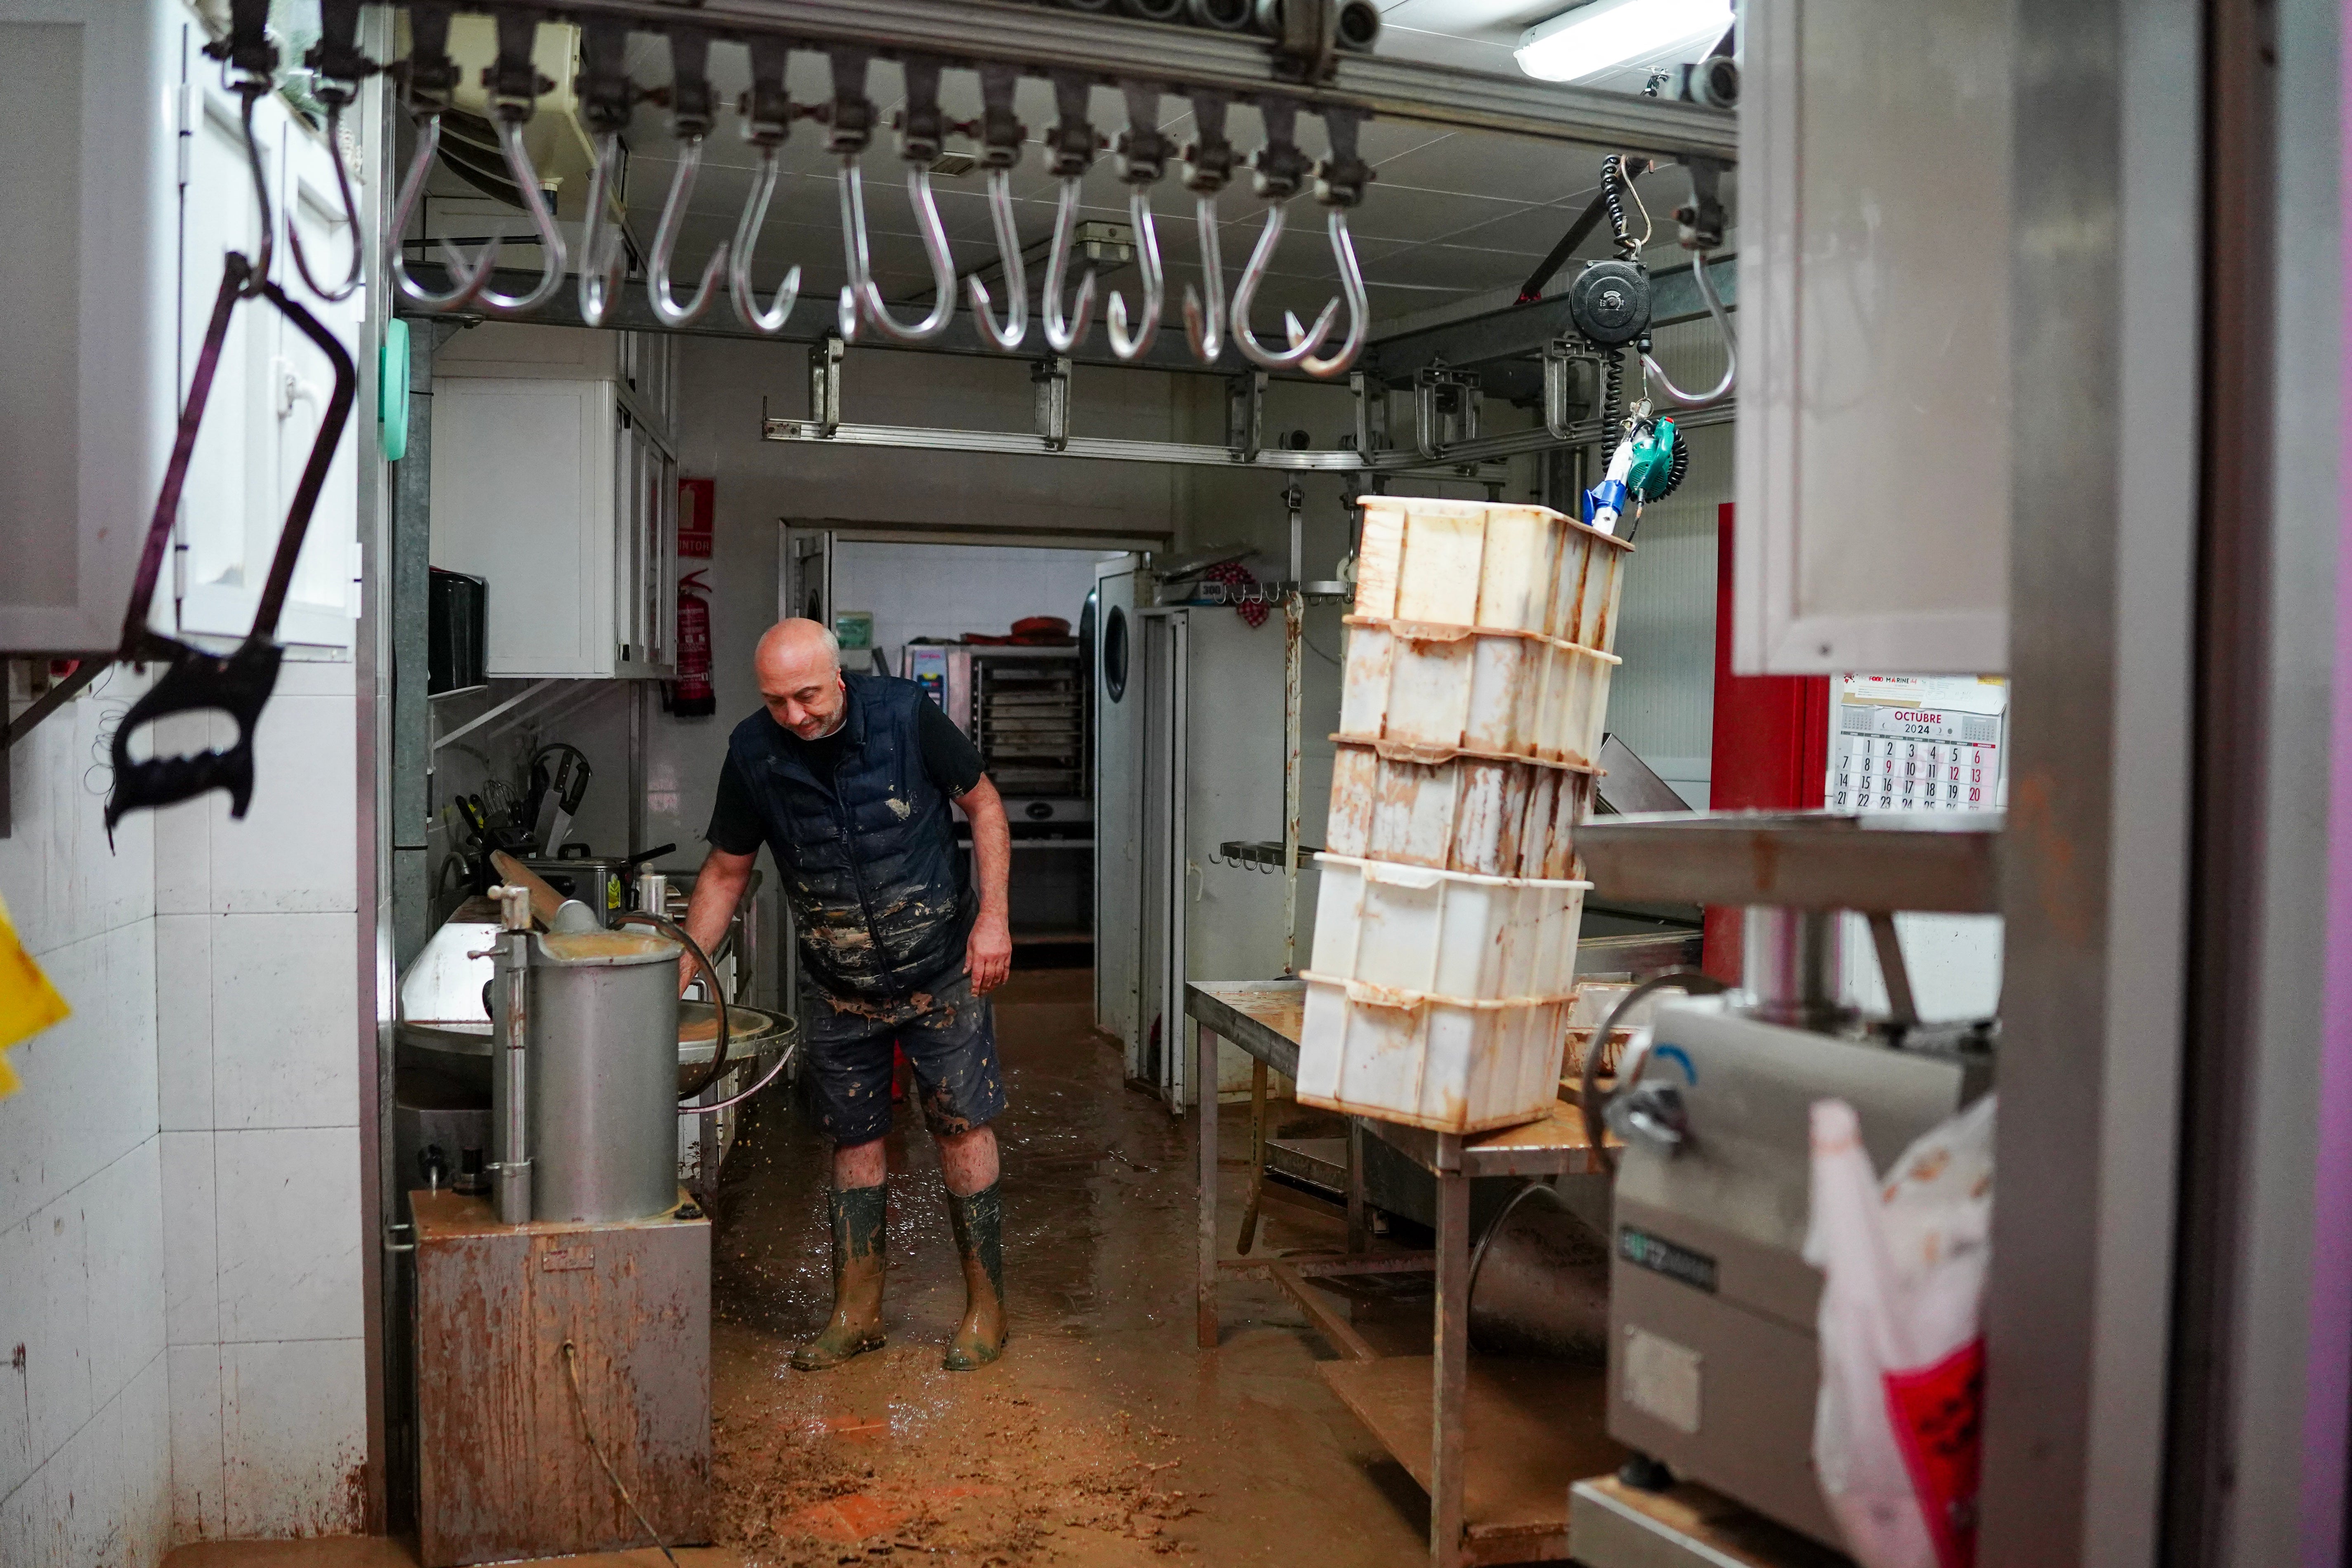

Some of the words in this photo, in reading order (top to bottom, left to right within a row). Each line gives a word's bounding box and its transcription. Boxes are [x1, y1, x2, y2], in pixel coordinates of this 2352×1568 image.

[1895, 711, 1941, 724] OCTUBRE
[1905, 724, 1929, 734] 2024
[1868, 740, 1870, 753] 1
[1887, 742, 1892, 755] 2
[1909, 744, 1914, 757] 3
[1931, 746, 1935, 759] 4
[1953, 749, 1958, 761] 5
[1975, 751, 1979, 764] 6
[1843, 756, 1849, 768] 7
[1865, 758, 1870, 771] 8
[1887, 760, 1891, 773] 9
[1907, 763, 1915, 776] 10
[1929, 765, 1935, 778] 11
[1950, 767, 1959, 780] 12
[1972, 769, 1981, 782] 13
[1840, 774, 1848, 786] 14
[1862, 776, 1870, 789] 15
[1884, 778, 1892, 791] 16
[1905, 781, 1913, 793] 17
[1927, 783, 1935, 796] 18
[1950, 785, 1958, 798] 19
[1969, 788, 1979, 801] 20
[1838, 791, 1846, 804] 21
[1858, 794, 1869, 807] 22
[1880, 796, 1891, 808] 23
[1902, 799, 1912, 808] 24
